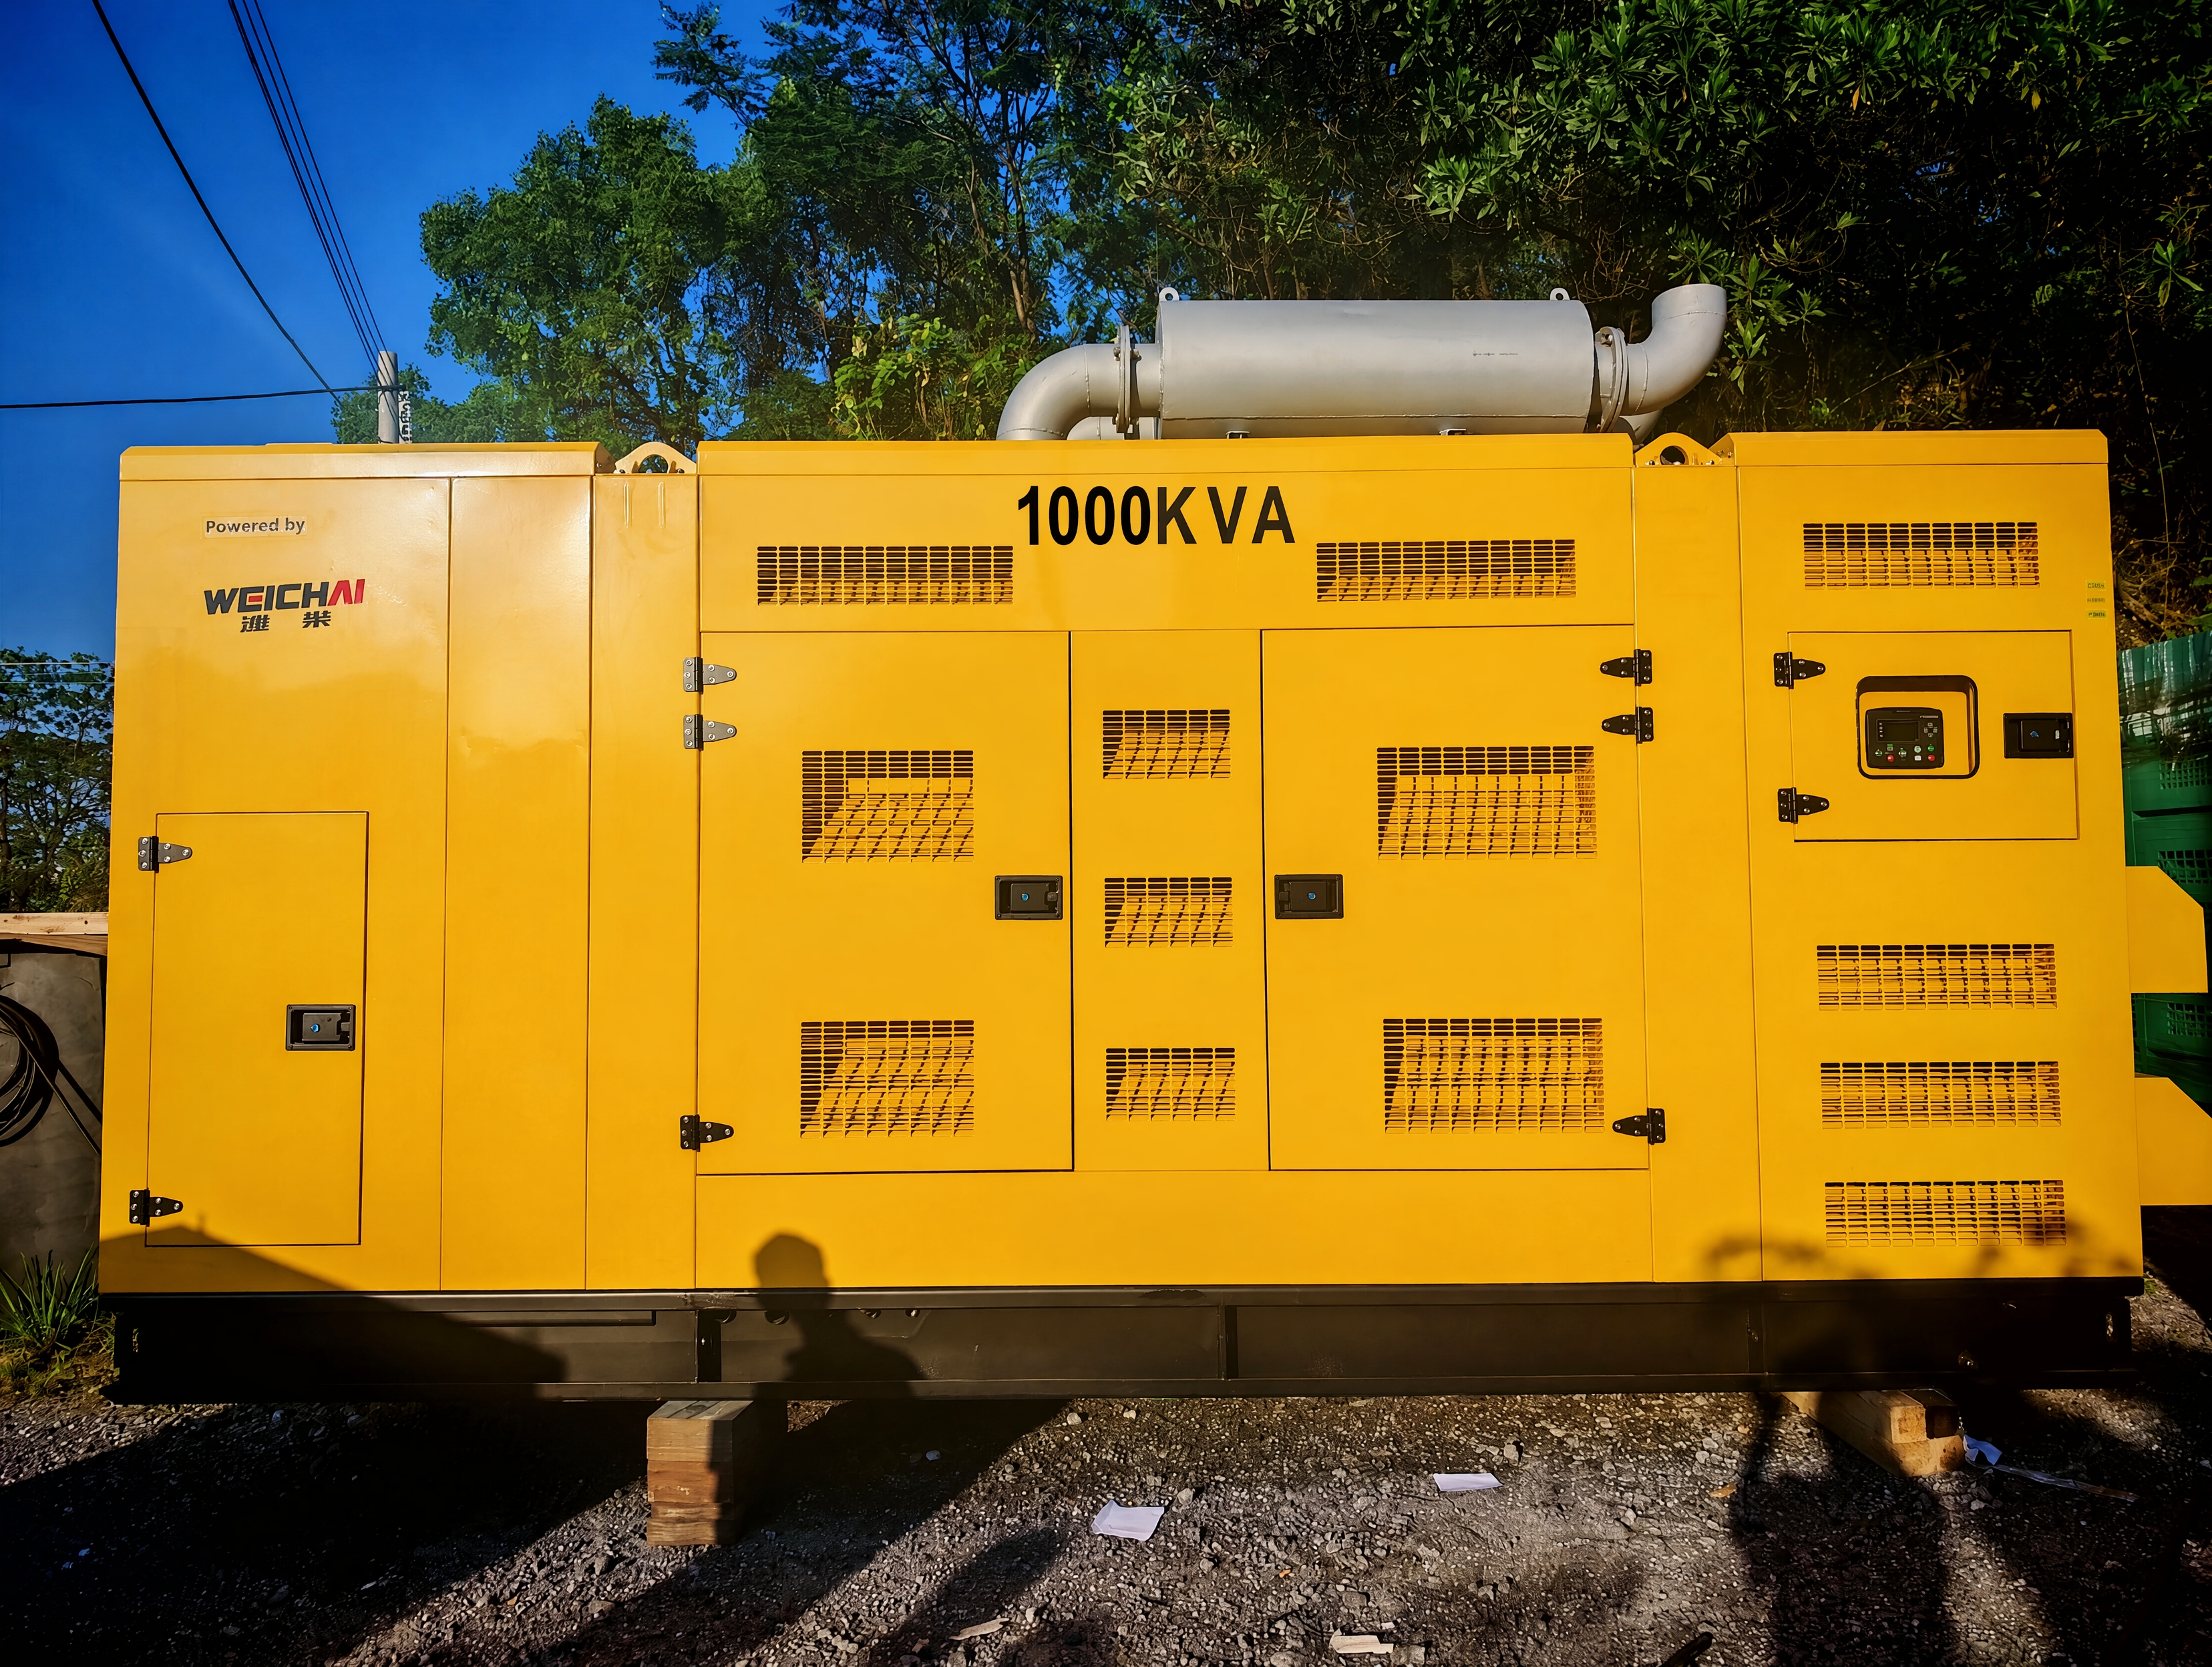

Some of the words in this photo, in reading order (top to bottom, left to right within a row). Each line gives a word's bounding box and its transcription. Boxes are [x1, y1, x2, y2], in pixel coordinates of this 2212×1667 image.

[206, 518, 279, 534] Powered
[285, 518, 305, 535] by
[1018, 486, 1296, 546] 1000KVA
[204, 578, 365, 615] WEICHAI
